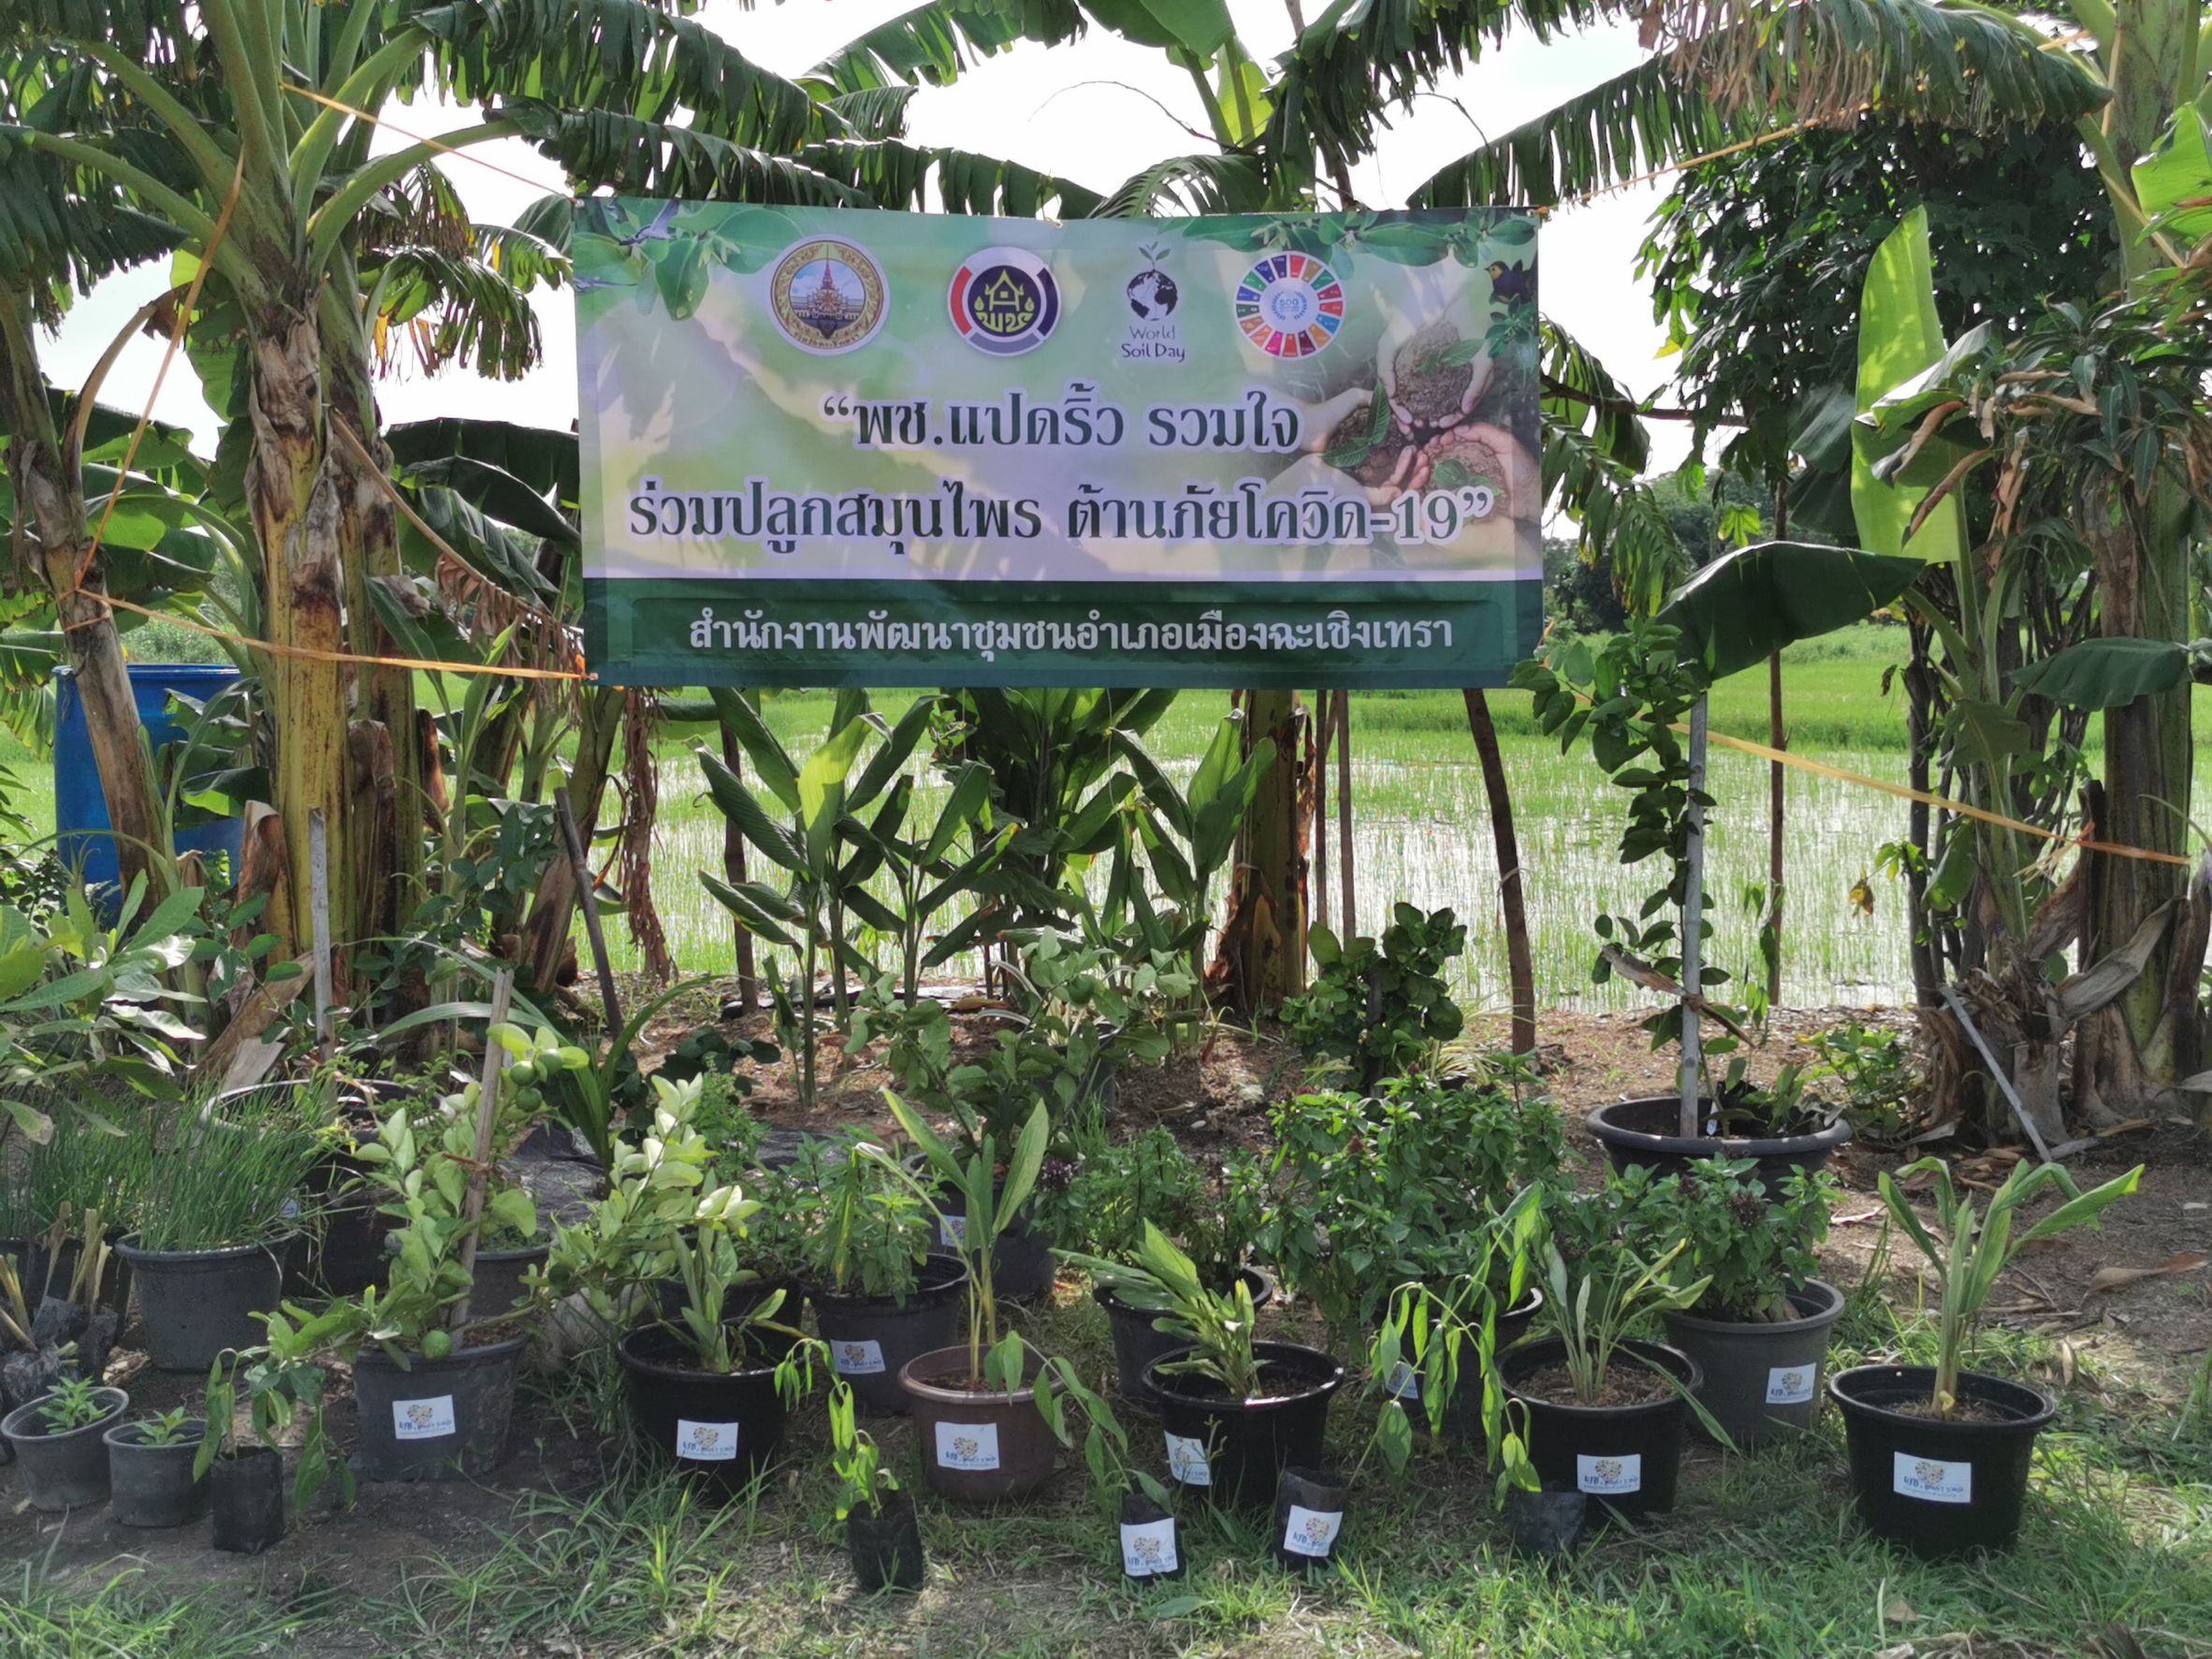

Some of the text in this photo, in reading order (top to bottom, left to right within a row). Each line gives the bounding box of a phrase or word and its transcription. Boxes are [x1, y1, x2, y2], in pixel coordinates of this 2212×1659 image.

[1121, 342, 1186, 363] Soil Day
[1129, 325, 1176, 341] World
[1147, 390, 1300, 447] รวมใจ
[630, 480, 1042, 555] ร่วมปลูกสมุนไพร
[690, 606, 1453, 662] สำนักงานพัฒนาชุมชนอำเภอเมืองฉะเชิงเทรา
